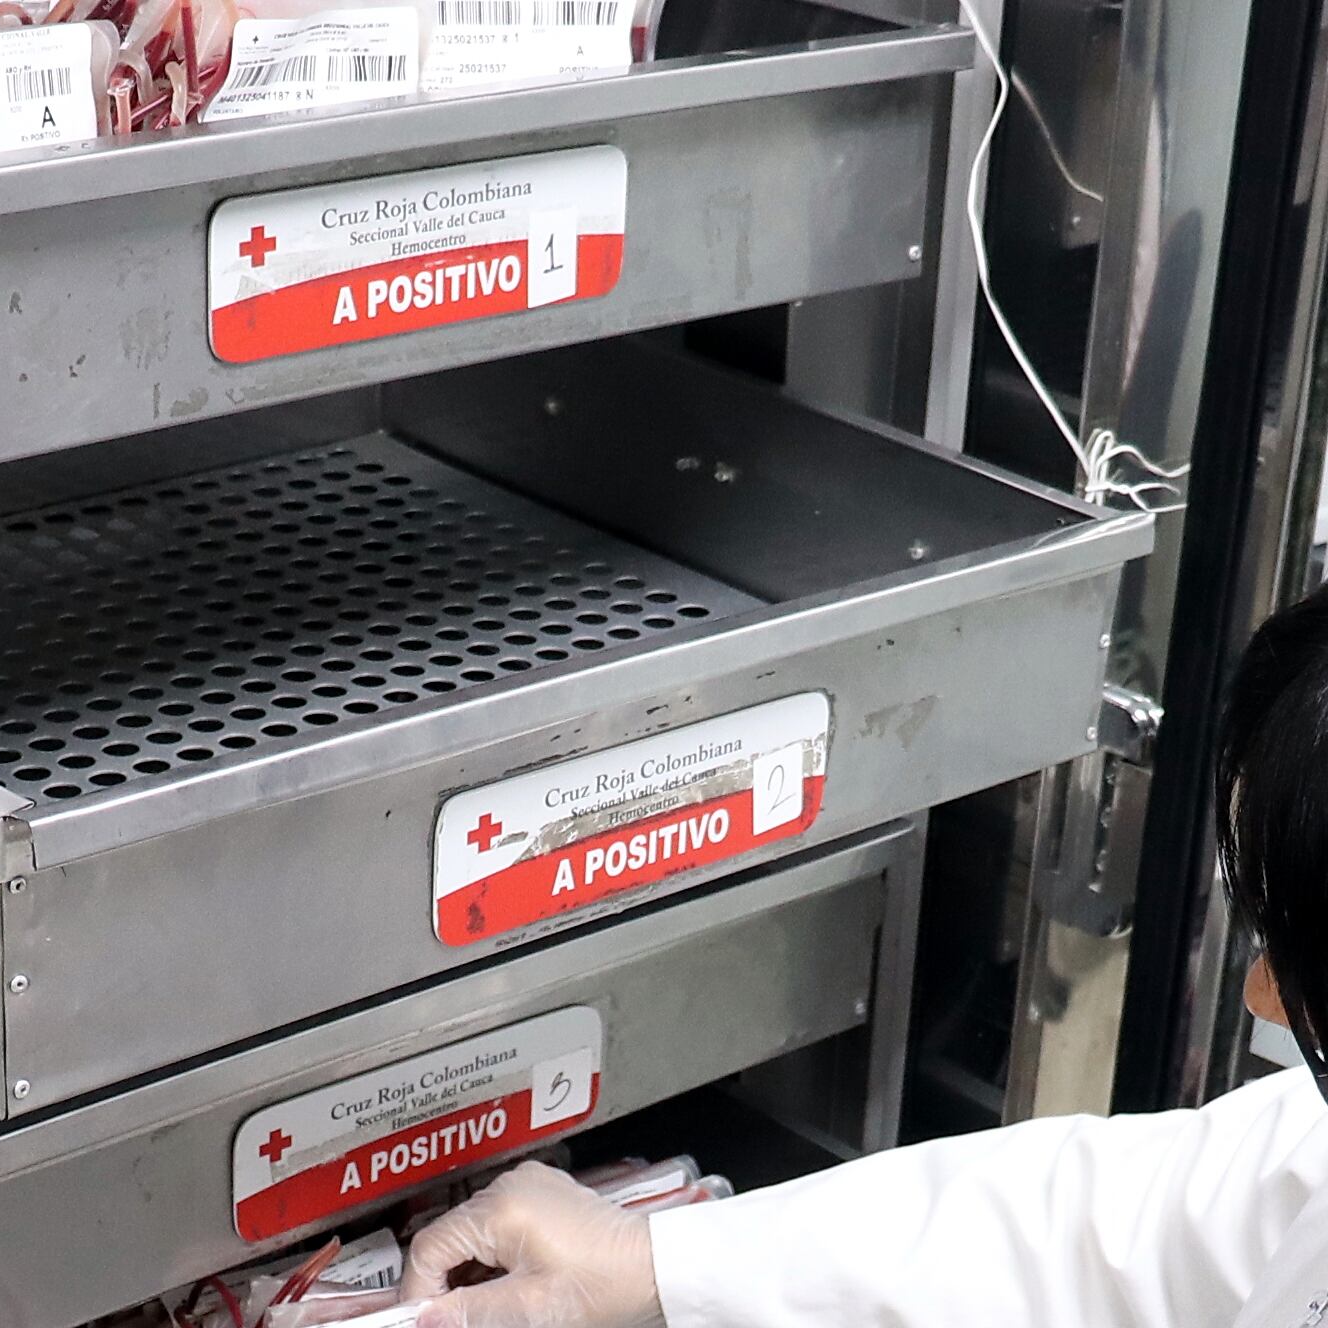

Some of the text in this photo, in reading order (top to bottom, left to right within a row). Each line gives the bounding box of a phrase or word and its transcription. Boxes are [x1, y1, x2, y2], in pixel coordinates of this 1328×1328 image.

[577, 45, 584, 56] A
[42, 105, 56, 128] A
[306, 89, 314, 100] N
[321, 182, 532, 229] Cruz Roja Colombiana
[349, 207, 506, 246] Seccional Valle del Cauca
[391, 233, 467, 257] Hemocentro
[543, 232, 564, 275] 1
[332, 255, 522, 325] A POSITIVO
[544, 738, 743, 809] Cruz Roja Colombiana
[571, 767, 717, 820] Seccional Valle del Cauca
[767, 764, 799, 816] 2
[608, 794, 681, 826] Hemocentro
[551, 808, 731, 897] A POSITIVO
[330, 1047, 518, 1121] Cruz Roja Colombiana
[355, 1073, 494, 1129] Seccional Valle del Cauca
[391, 1100, 459, 1131] Hemocentro
[339, 1106, 509, 1195] A POSITIVO
